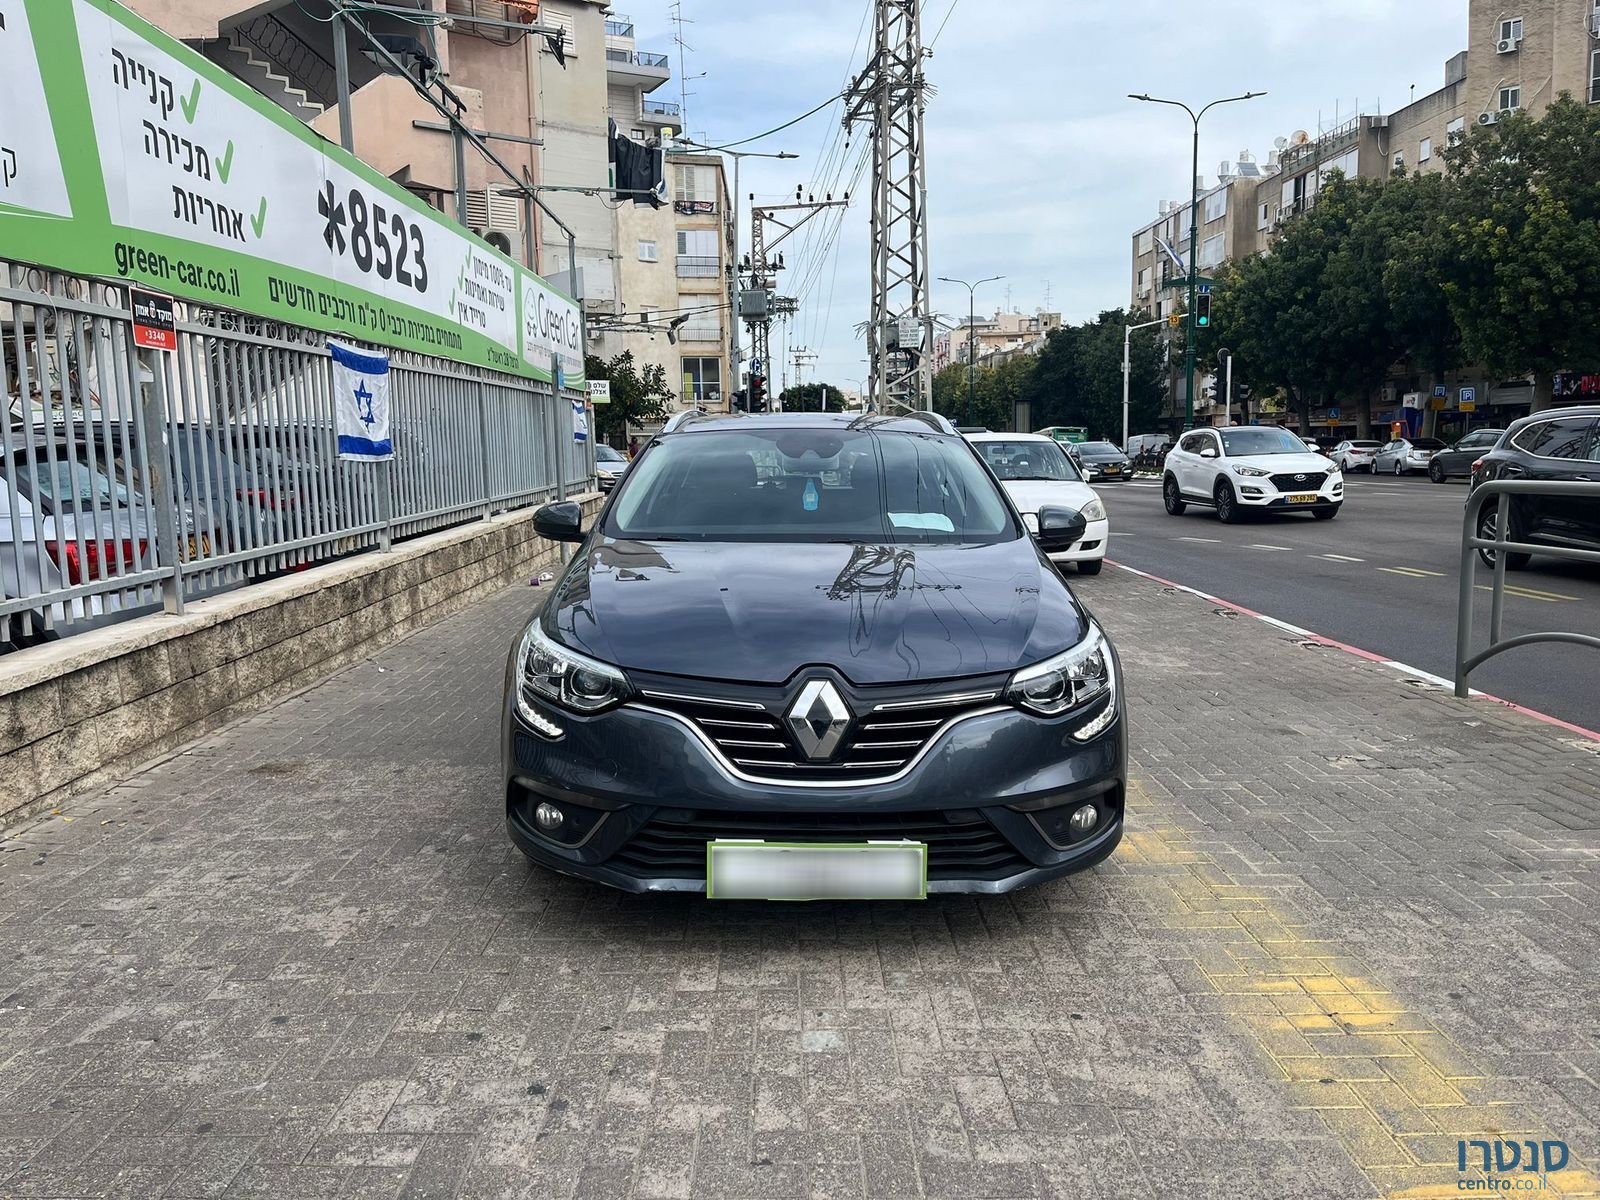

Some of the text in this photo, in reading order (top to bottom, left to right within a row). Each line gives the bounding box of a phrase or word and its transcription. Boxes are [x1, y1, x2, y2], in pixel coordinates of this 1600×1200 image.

[111, 48, 174, 121] קנייה
[143, 119, 211, 181] מכירה
[172, 185, 246, 242] אחריות
[115, 242, 240, 297] green-car.co.il
[473, 256, 489, 280] מימון
[268, 276, 316, 312] חדשים
[318, 292, 355, 323] ורכבים
[379, 307, 386, 332] 0
[387, 314, 407, 337] רכבי
[458, 301, 469, 325] אין
[538, 292, 579, 351] Green Car
[408, 320, 436, 344] במכירת
[436, 328, 463, 350] מתמחים
